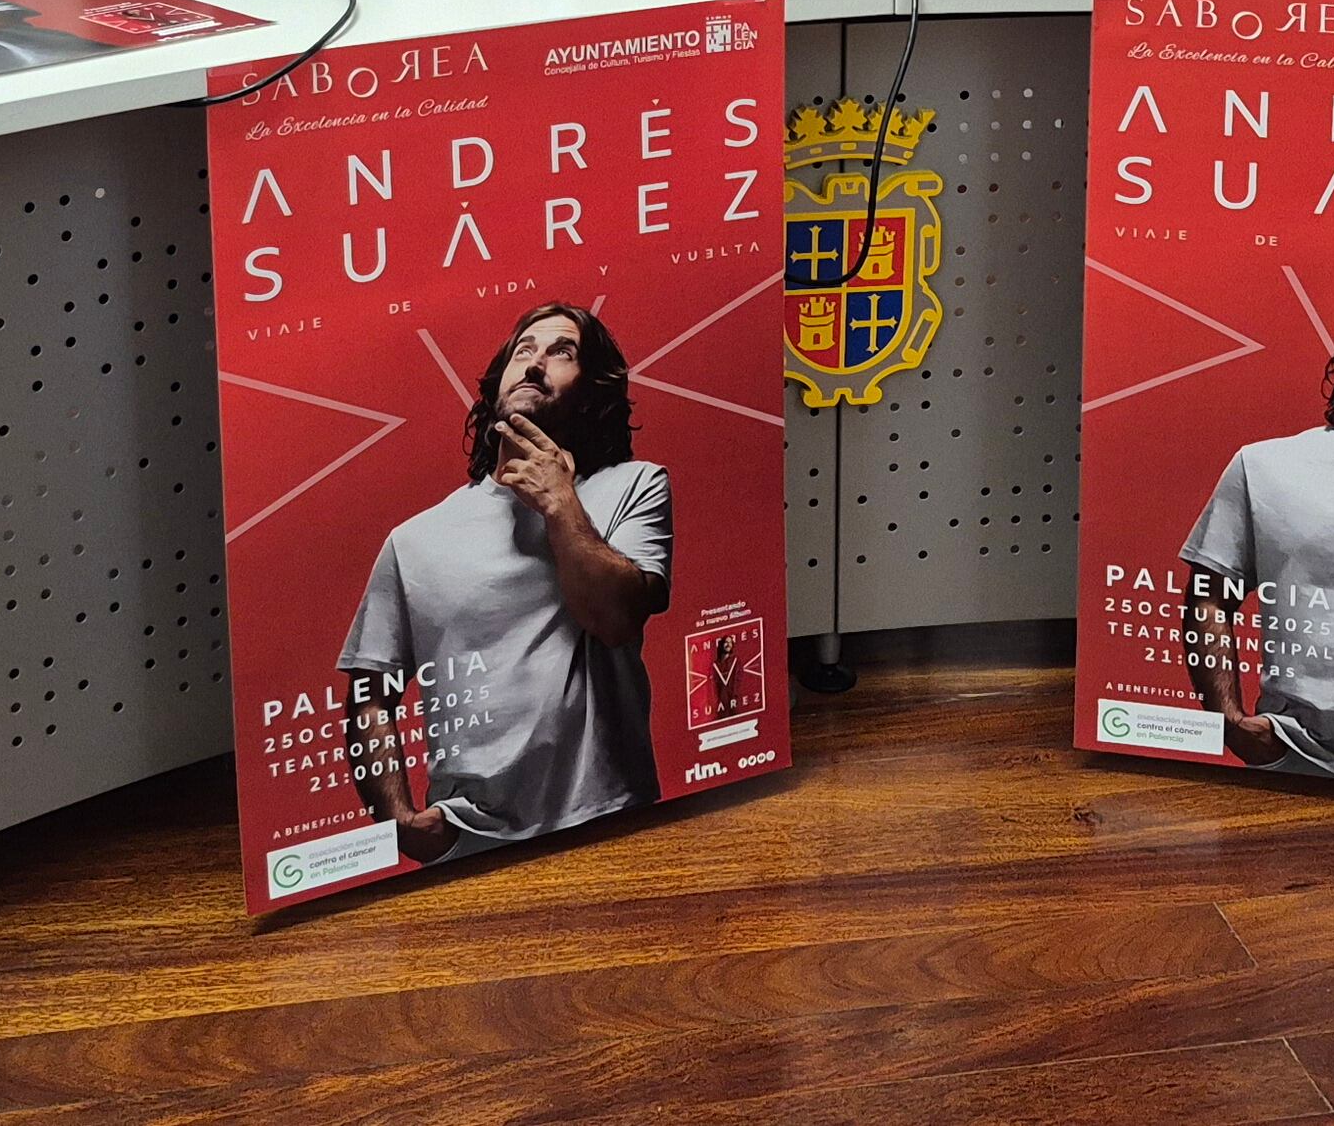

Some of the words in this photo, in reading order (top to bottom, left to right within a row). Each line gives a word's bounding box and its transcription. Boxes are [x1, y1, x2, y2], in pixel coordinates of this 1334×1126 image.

[545, 30, 700, 66] AYUNTAMIENTO
[734, 22, 750, 31] PA
[734, 40, 755, 51] CIA
[735, 30, 758, 41] LEN
[588, 61, 598, 70] de
[634, 54, 663, 64] Turismo
[665, 53, 671, 61] y
[673, 48, 700, 59] Fiestas
[1128, 42, 1153, 59] La
[1158, 44, 1248, 63] Excelencia
[1252, 55, 1271, 64] en
[1276, 53, 1294, 66] la
[245, 122, 272, 141] La
[277, 114, 367, 137] Excelencia
[372, 111, 390, 123] en
[395, 106, 412, 119] la
[418, 95, 489, 117] Calidad
[1115, 226, 1188, 241] VIAJE
[1254, 234, 1278, 248] DE
[247, 316, 323, 341] VIAJE
[389, 301, 412, 315] DE
[477, 278, 536, 298] VIDA
[599, 265, 609, 277] Y
[671, 241, 760, 265] VUELTA
[1106, 565, 1330, 610] PALENCIA
[701, 600, 746, 617] Presentando
[264, 651, 487, 726] PALENCIA
[1106, 681, 1113, 690] A
[1117, 683, 1185, 699] BENEFICIO
[1189, 691, 1204, 701] DE
[273, 831, 281, 840] A
[285, 811, 355, 836] BENEFICIO
[359, 805, 375, 817] DE
